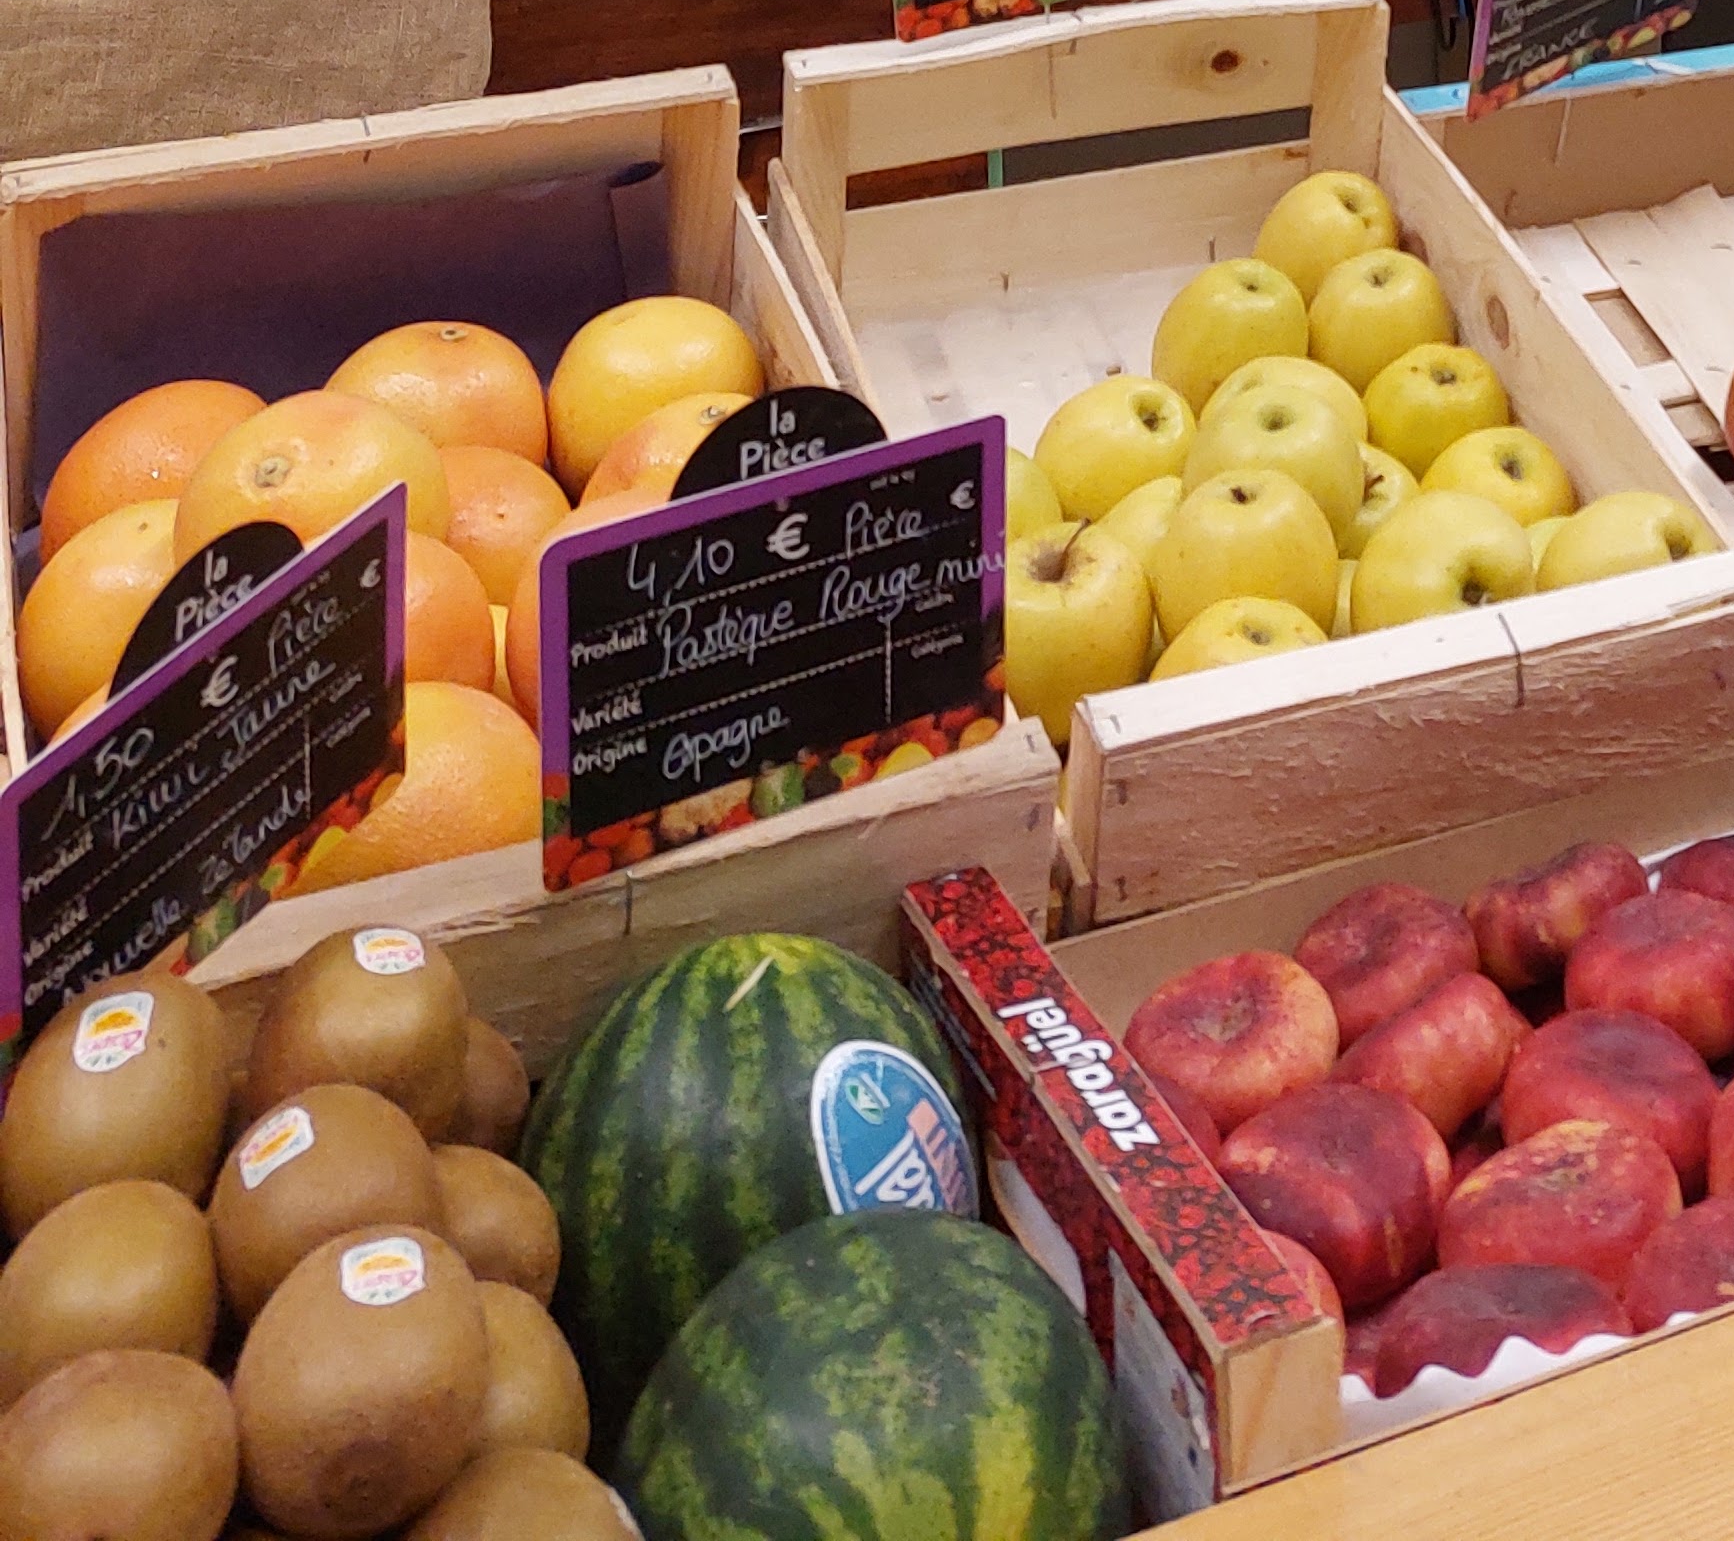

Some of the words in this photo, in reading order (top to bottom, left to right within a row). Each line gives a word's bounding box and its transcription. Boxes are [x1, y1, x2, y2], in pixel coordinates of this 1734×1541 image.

[769, 398, 796, 436] la
[740, 435, 826, 479] Pièce
[204, 549, 229, 588] la
[626, 535, 735, 609] 4,10
[766, 514, 811, 560] €
[844, 501, 930, 561] Pièce
[175, 573, 253, 641] Pièce
[571, 623, 647, 668] Produit
[656, 598, 795, 678] Pastèque
[820, 559, 933, 625] Rouge
[41, 728, 154, 842] 1,50
[202, 655, 239, 708] €
[269, 596, 343, 677] Pièce
[571, 690, 643, 735] Variété
[572, 735, 647, 776] Origine
[23, 825, 96, 902] Produit
[24, 893, 90, 968] Variété
[24, 940, 96, 1007] Origine
[996, 995, 1161, 1152] zaragüel
